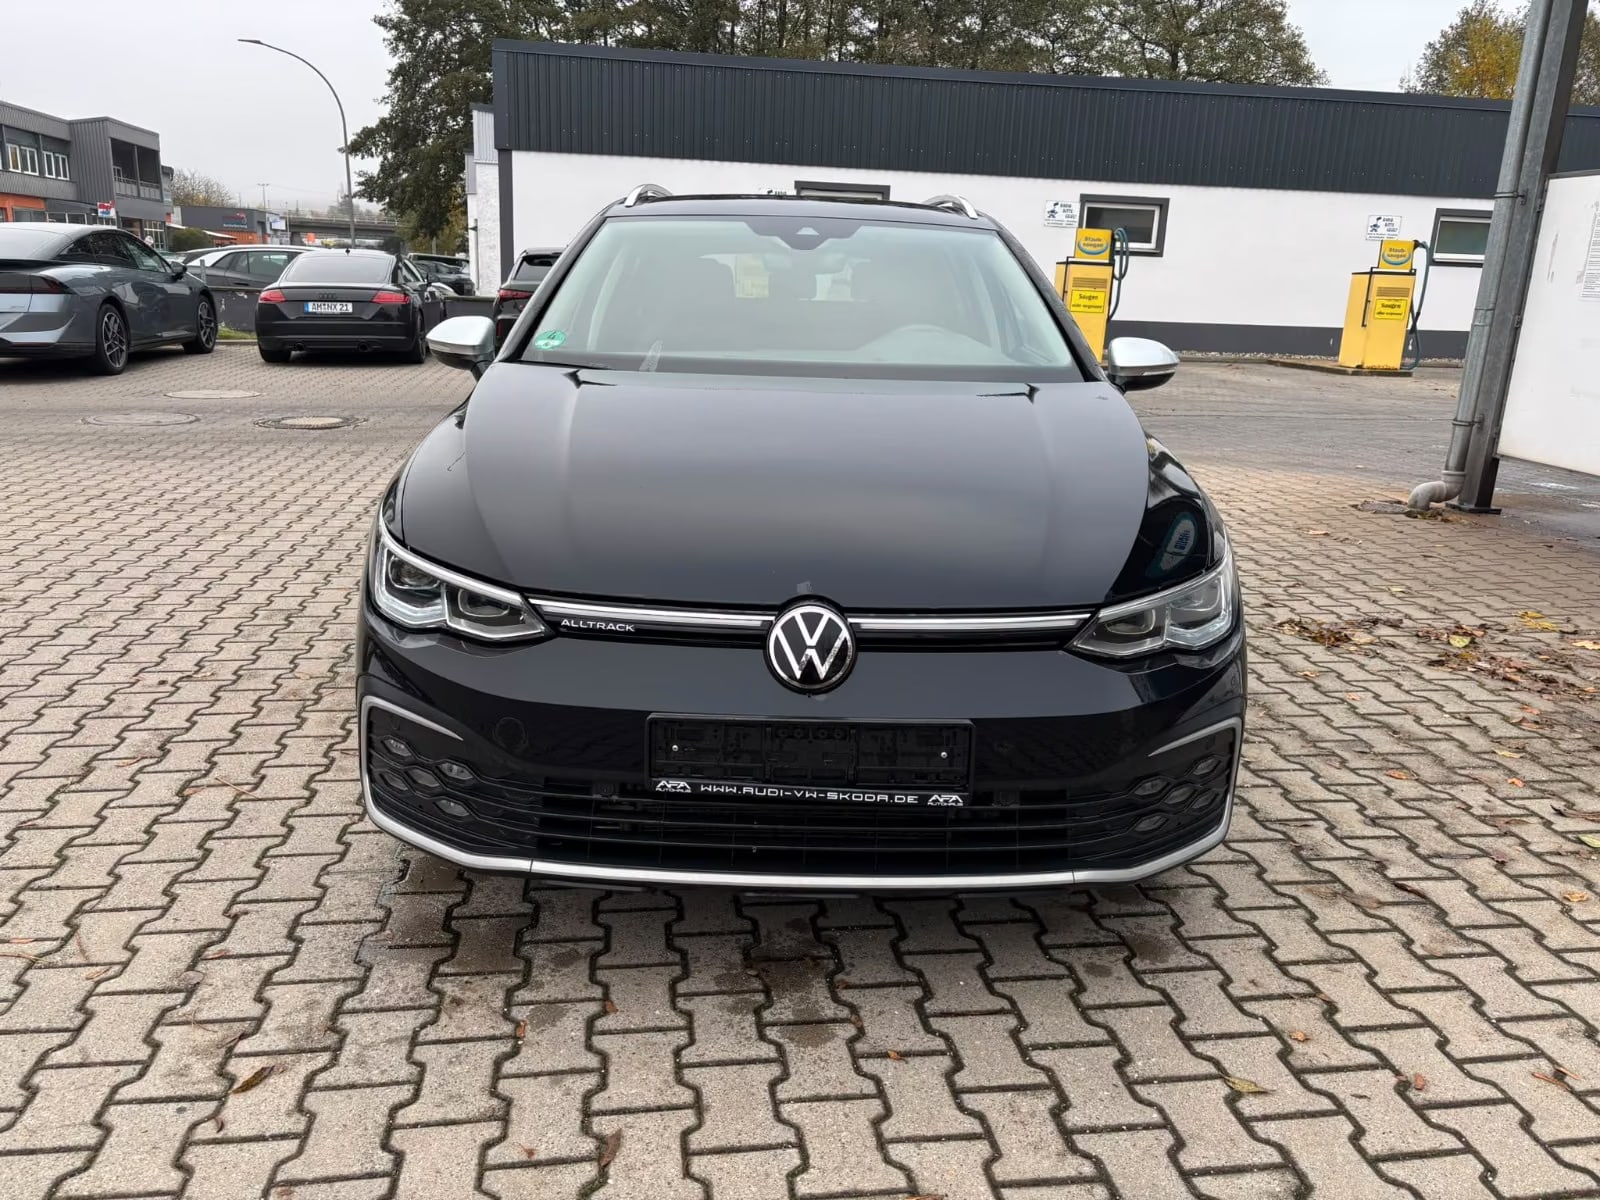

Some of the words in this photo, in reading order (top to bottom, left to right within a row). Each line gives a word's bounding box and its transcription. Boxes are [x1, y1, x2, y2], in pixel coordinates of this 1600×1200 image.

[561, 619, 635, 632] ALLTRACK
[656, 780, 691, 788] AFA
[700, 784, 919, 804] WWW.AUDI-VW-SKODA.DE
[928, 794, 963, 803] AFA
